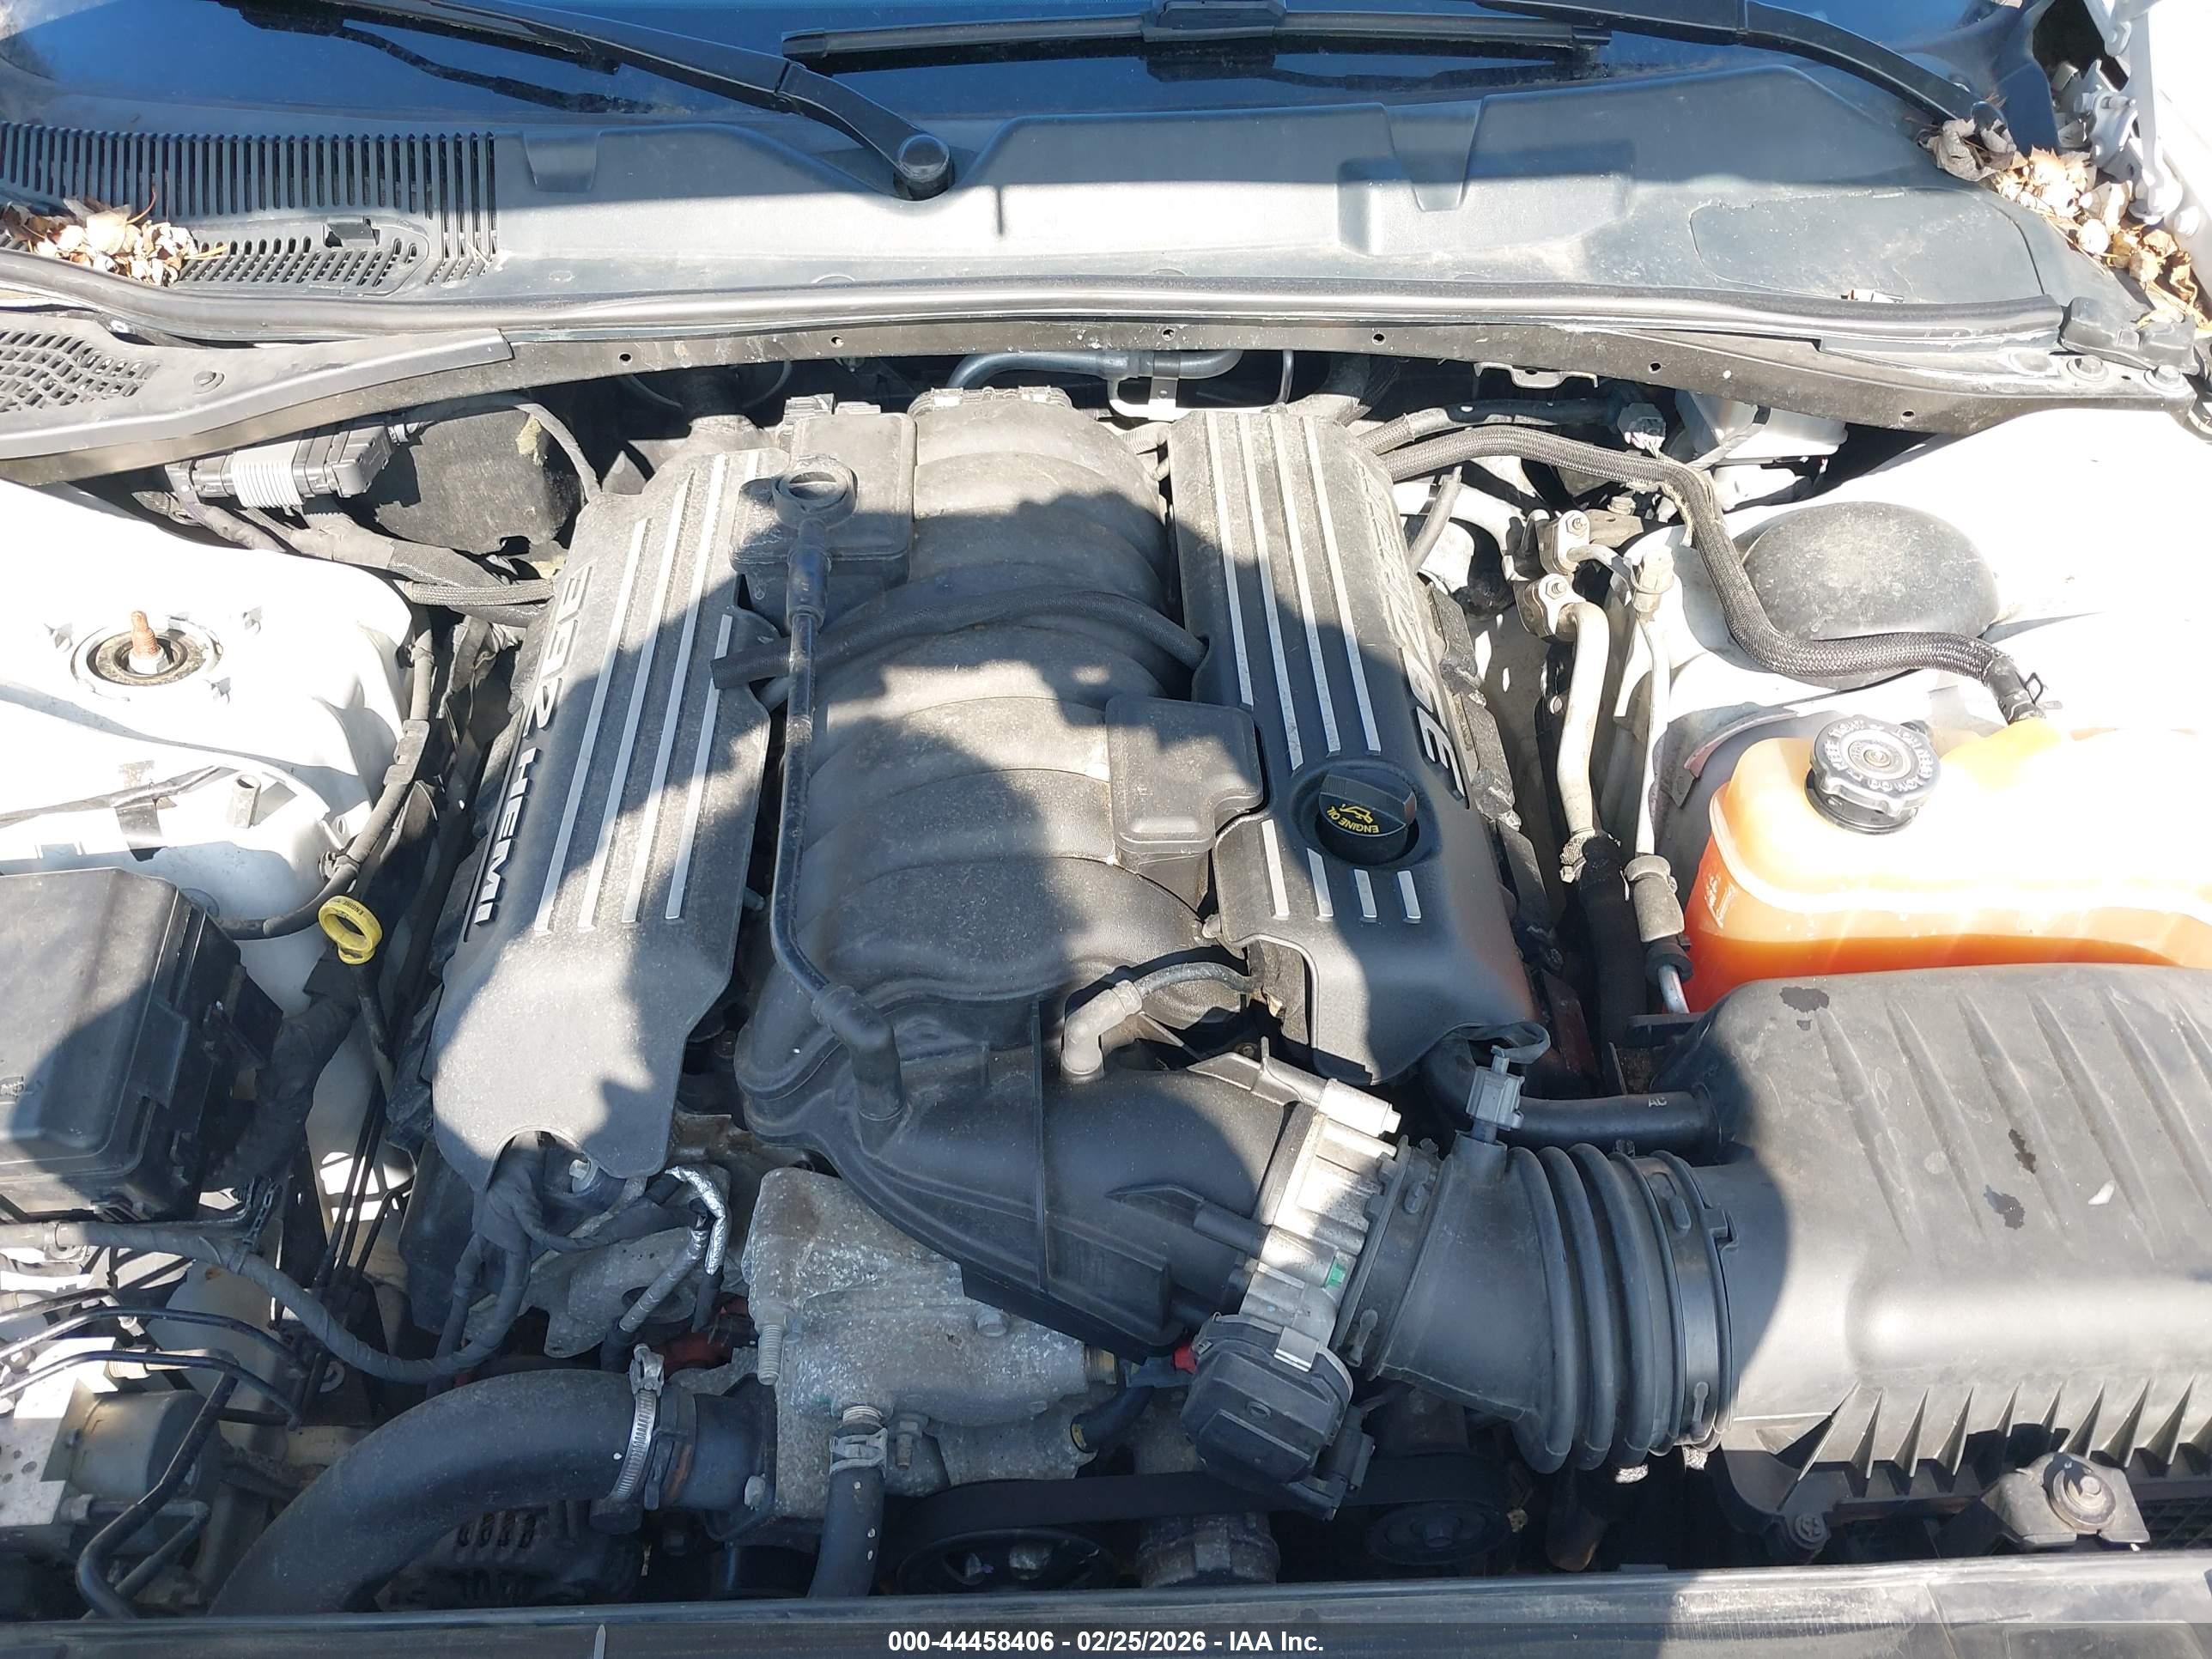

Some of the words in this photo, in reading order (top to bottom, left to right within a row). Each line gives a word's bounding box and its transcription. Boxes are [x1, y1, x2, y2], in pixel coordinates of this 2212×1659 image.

[521, 560, 596, 739] 392
[474, 747, 540, 925] HEMI
[1327, 805, 1340, 821] OIL
[1338, 817, 1380, 834] ENGINE
